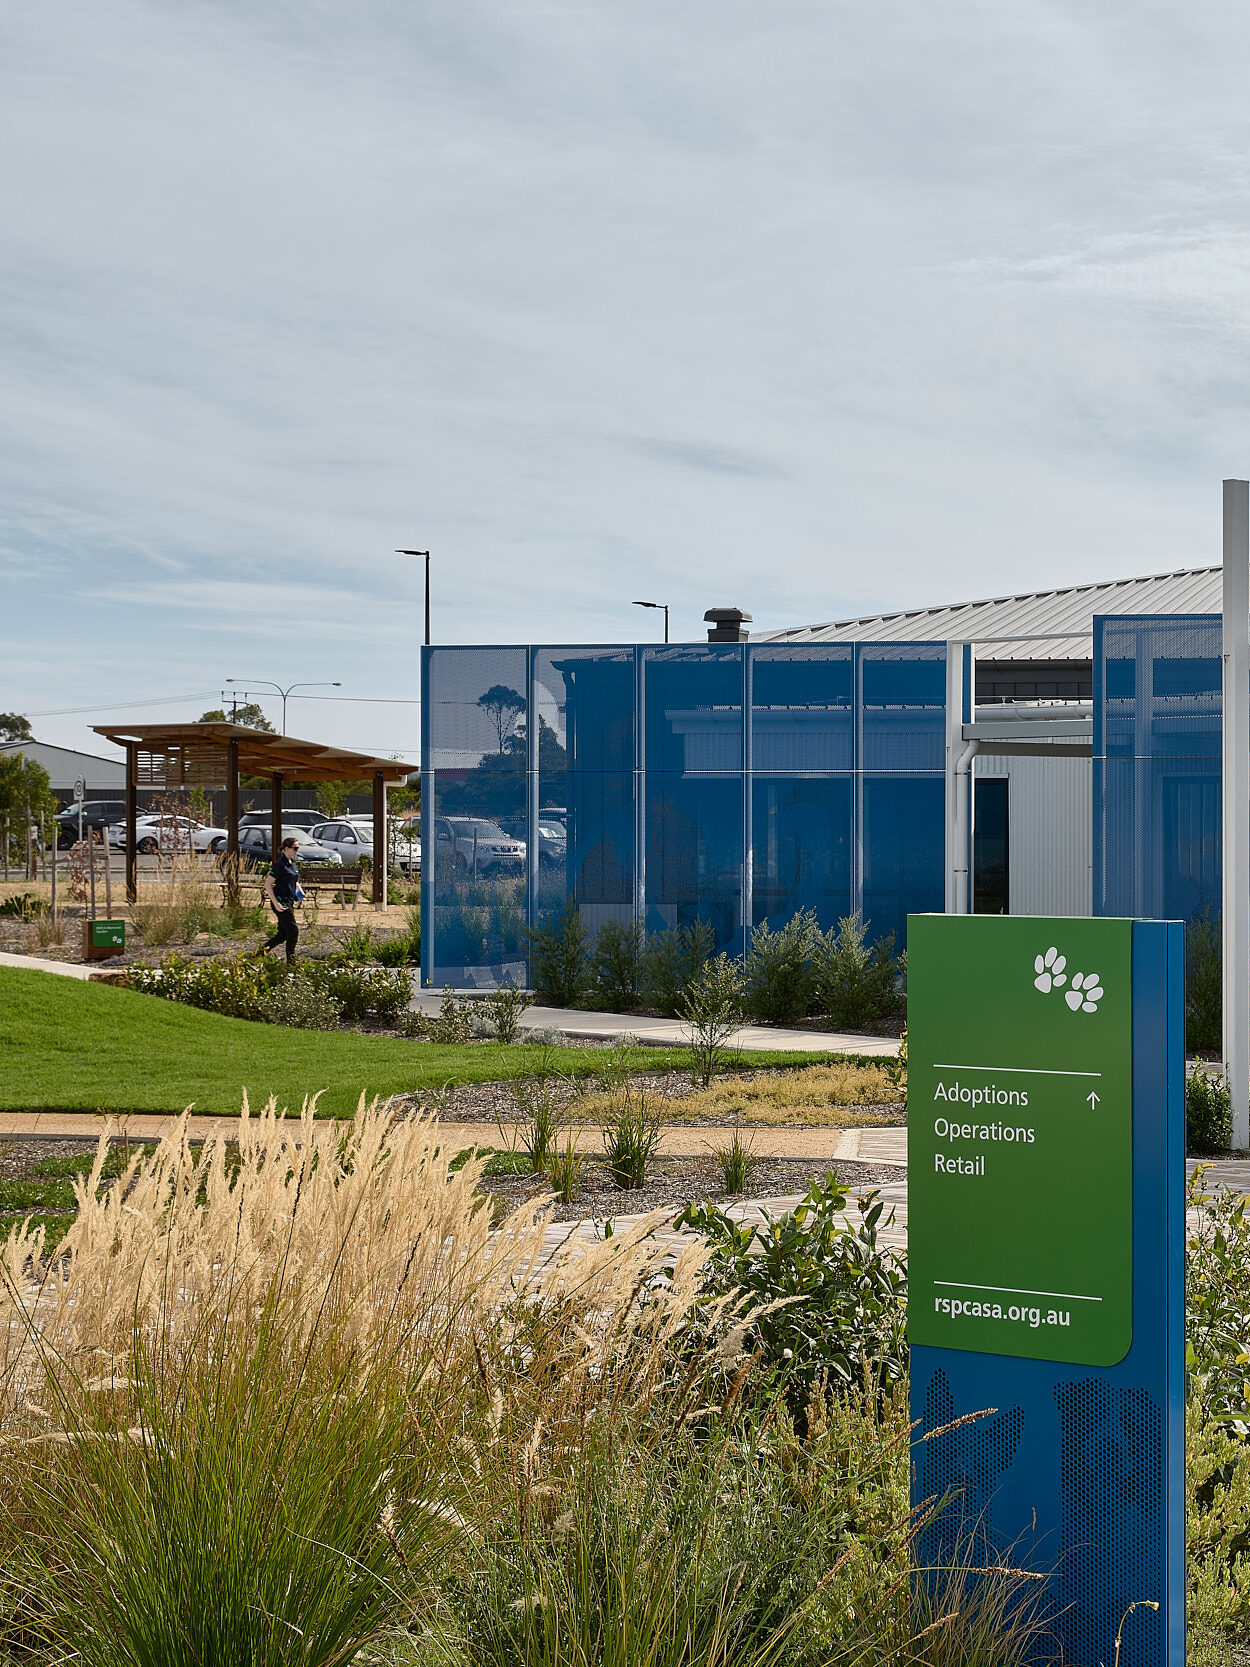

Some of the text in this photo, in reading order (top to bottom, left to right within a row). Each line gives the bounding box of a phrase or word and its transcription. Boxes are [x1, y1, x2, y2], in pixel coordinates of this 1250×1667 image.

[934, 1082, 1028, 1108] Adoptions
[935, 1118, 1035, 1144] Operations
[935, 1154, 985, 1176] Retail
[934, 1296, 1071, 1328] rspcasa.org.au
